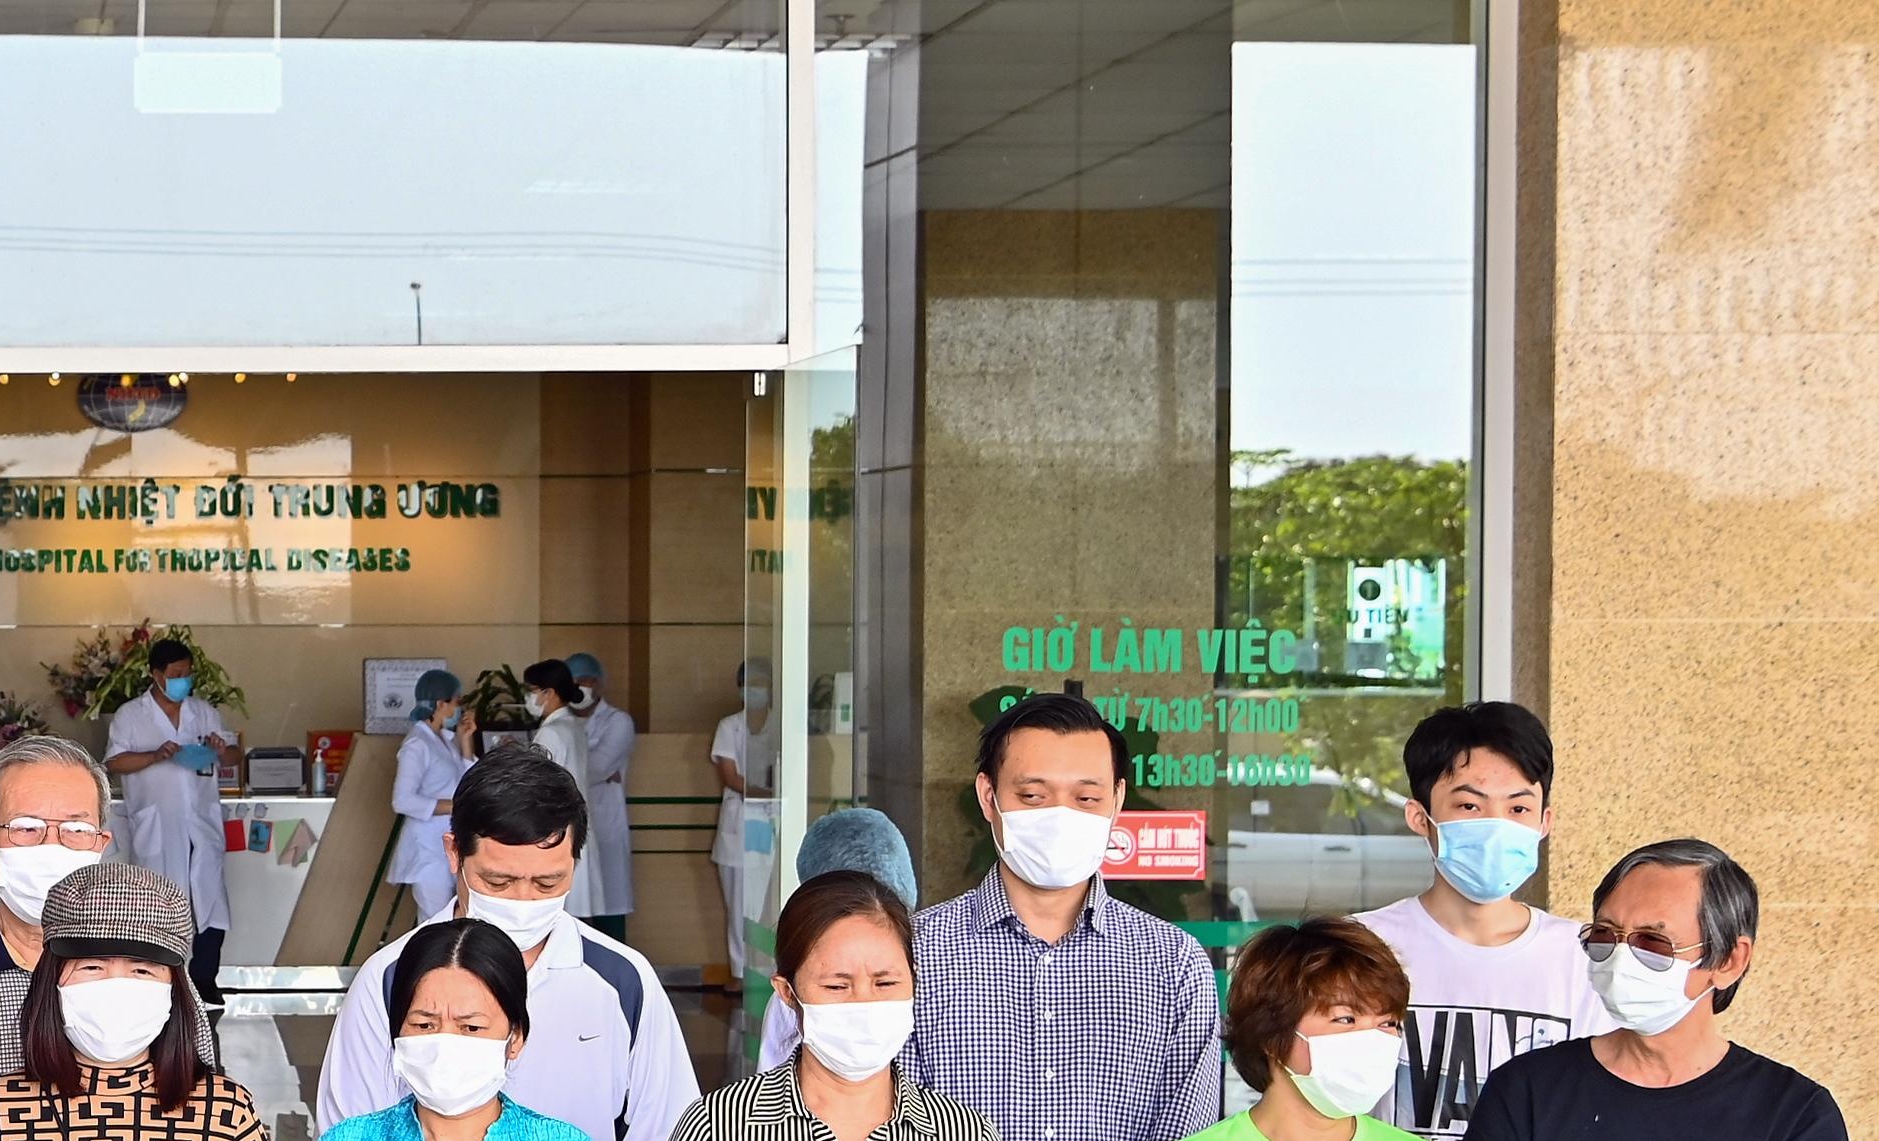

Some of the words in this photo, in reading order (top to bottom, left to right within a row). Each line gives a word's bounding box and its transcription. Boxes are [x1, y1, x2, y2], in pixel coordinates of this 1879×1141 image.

[76, 478, 181, 525] NHIỆT
[269, 483, 387, 519] TRUNG
[397, 480, 501, 519] ƯƠNG
[114, 549, 151, 573] FOR
[155, 548, 278, 572] TROPICAL
[287, 548, 411, 573] DISEASES
[1002, 614, 1079, 673] GIỜ
[1090, 616, 1182, 673] LÀM
[1196, 618, 1296, 683] VIỆC
